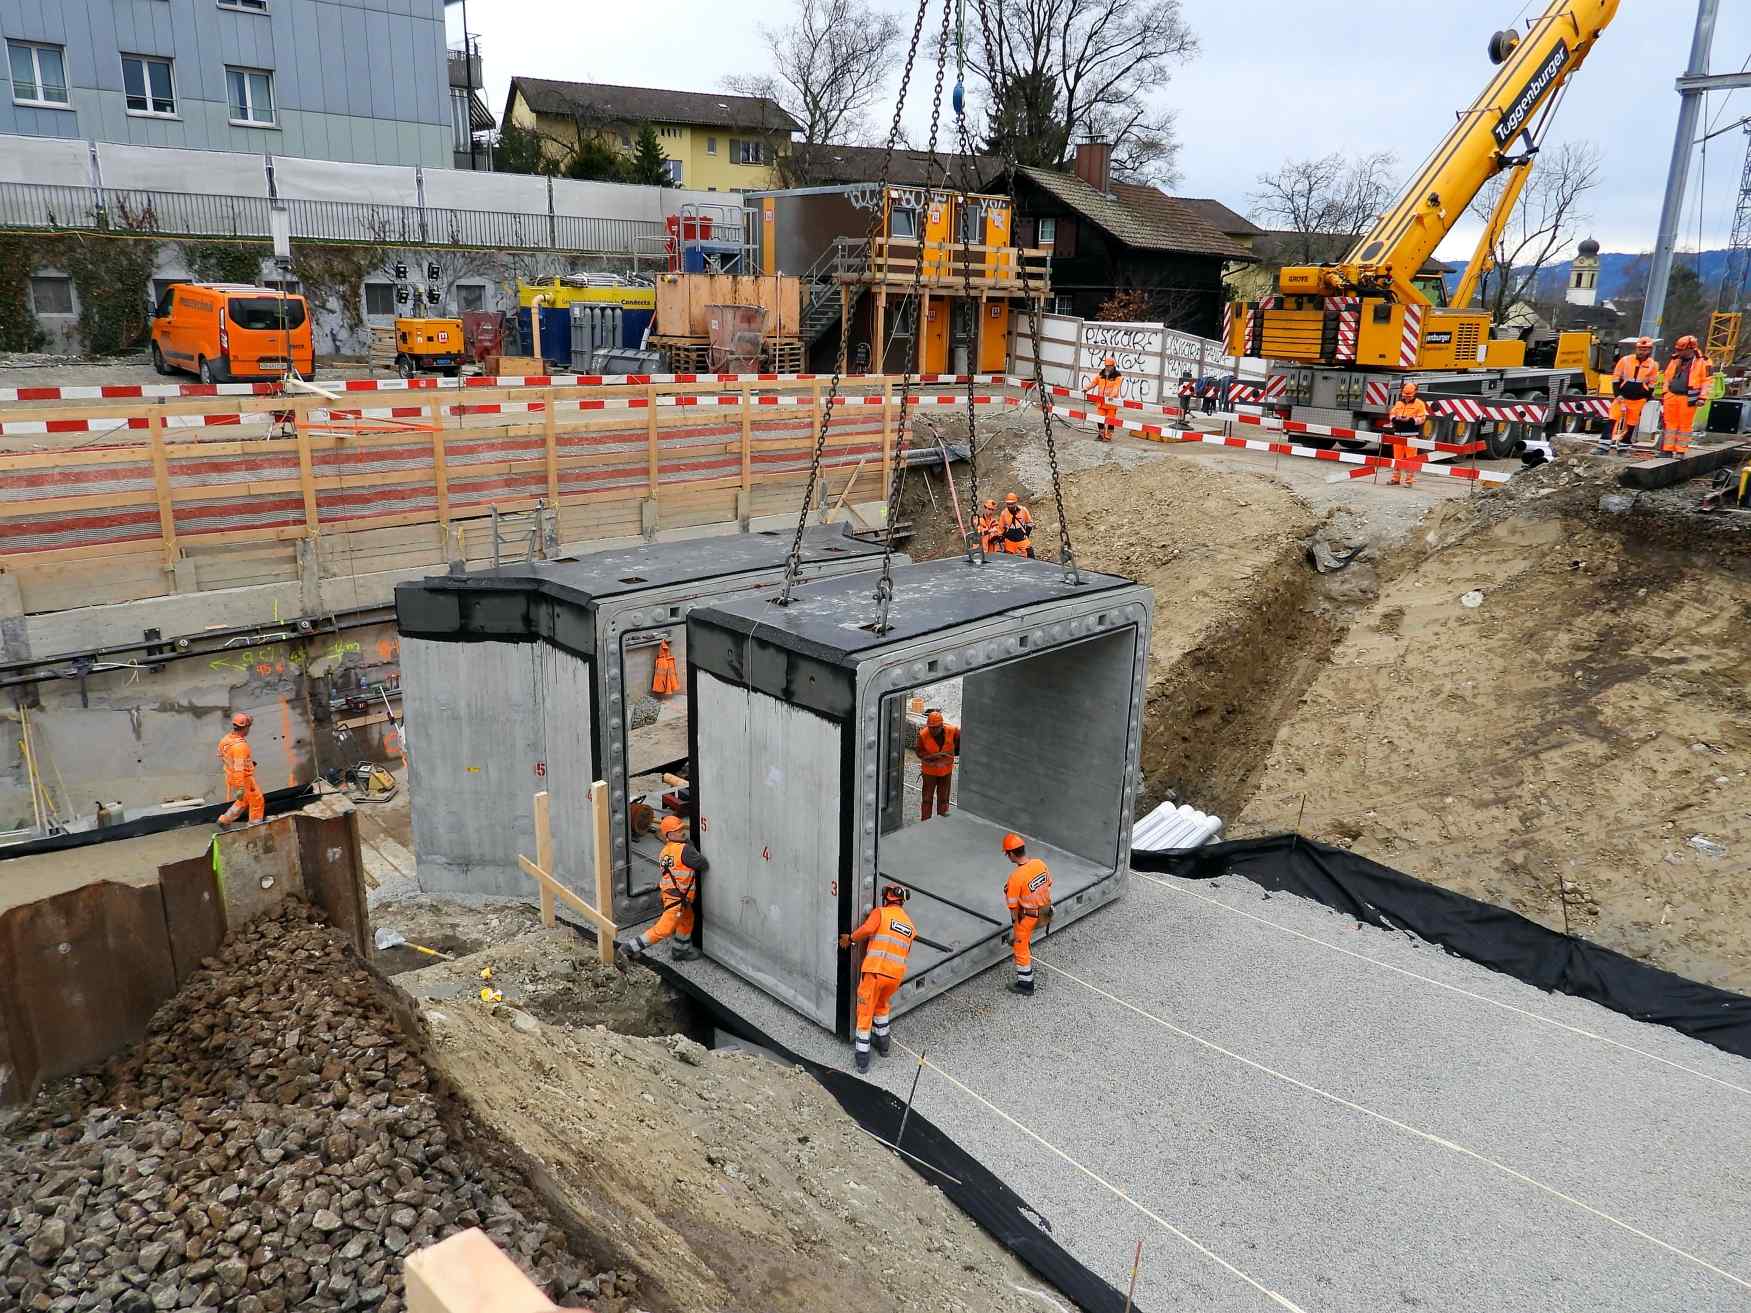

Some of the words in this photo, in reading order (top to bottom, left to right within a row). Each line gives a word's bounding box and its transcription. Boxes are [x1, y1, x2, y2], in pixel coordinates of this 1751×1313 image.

[1495, 46, 1565, 140] Tuggenburger
[536, 763, 546, 777] 5
[700, 816, 708, 832] 5
[762, 845, 770, 862] 4
[831, 880, 838, 896] 3
